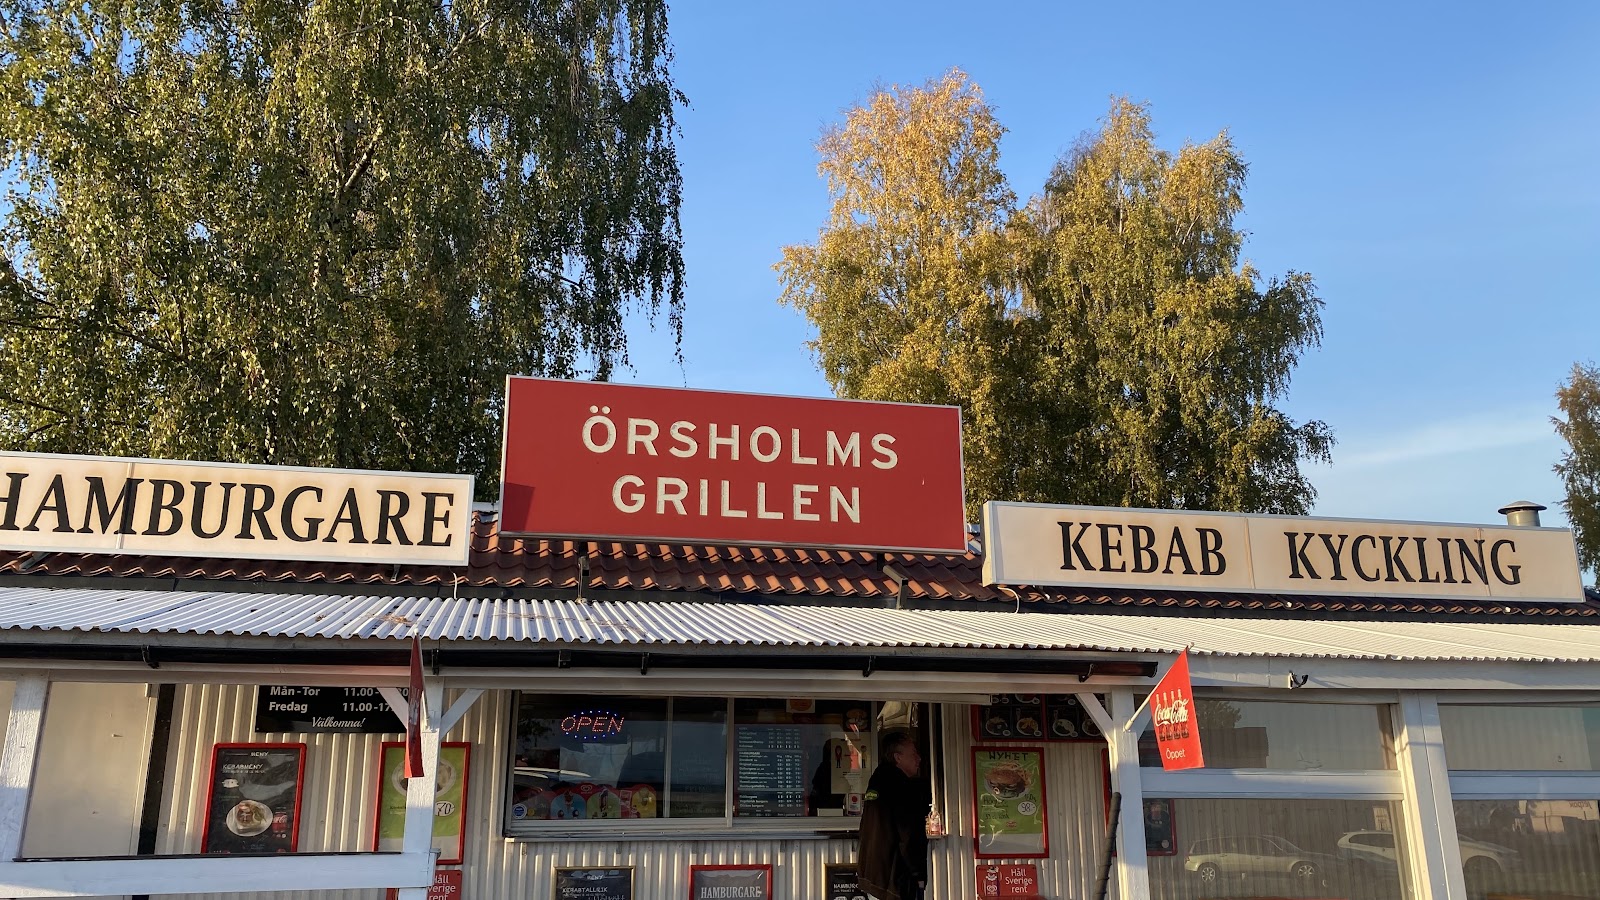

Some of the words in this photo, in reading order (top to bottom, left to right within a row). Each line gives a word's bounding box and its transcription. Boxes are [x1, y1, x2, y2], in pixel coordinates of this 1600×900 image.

[582, 405, 899, 471] ÖRSHOLMS
[611, 474, 861, 524] GRILLEN
[0, 472, 455, 547] HAMBURGARE
[1057, 521, 1227, 577] KEBAB
[1284, 531, 1522, 586] KYCKLING
[269, 701, 308, 714] Fredag
[311, 716, 366, 728] Välkomna!
[561, 715, 626, 732] OPEN
[988, 751, 1029, 761] NYHET
[1166, 747, 1186, 760] Öppet
[1010, 867, 1027, 877] Håll
[1005, 876, 1033, 887] Sverige
[428, 884, 456, 894] verige
[700, 885, 761, 899] HAMBURGARE
[1011, 885, 1028, 893] rent
